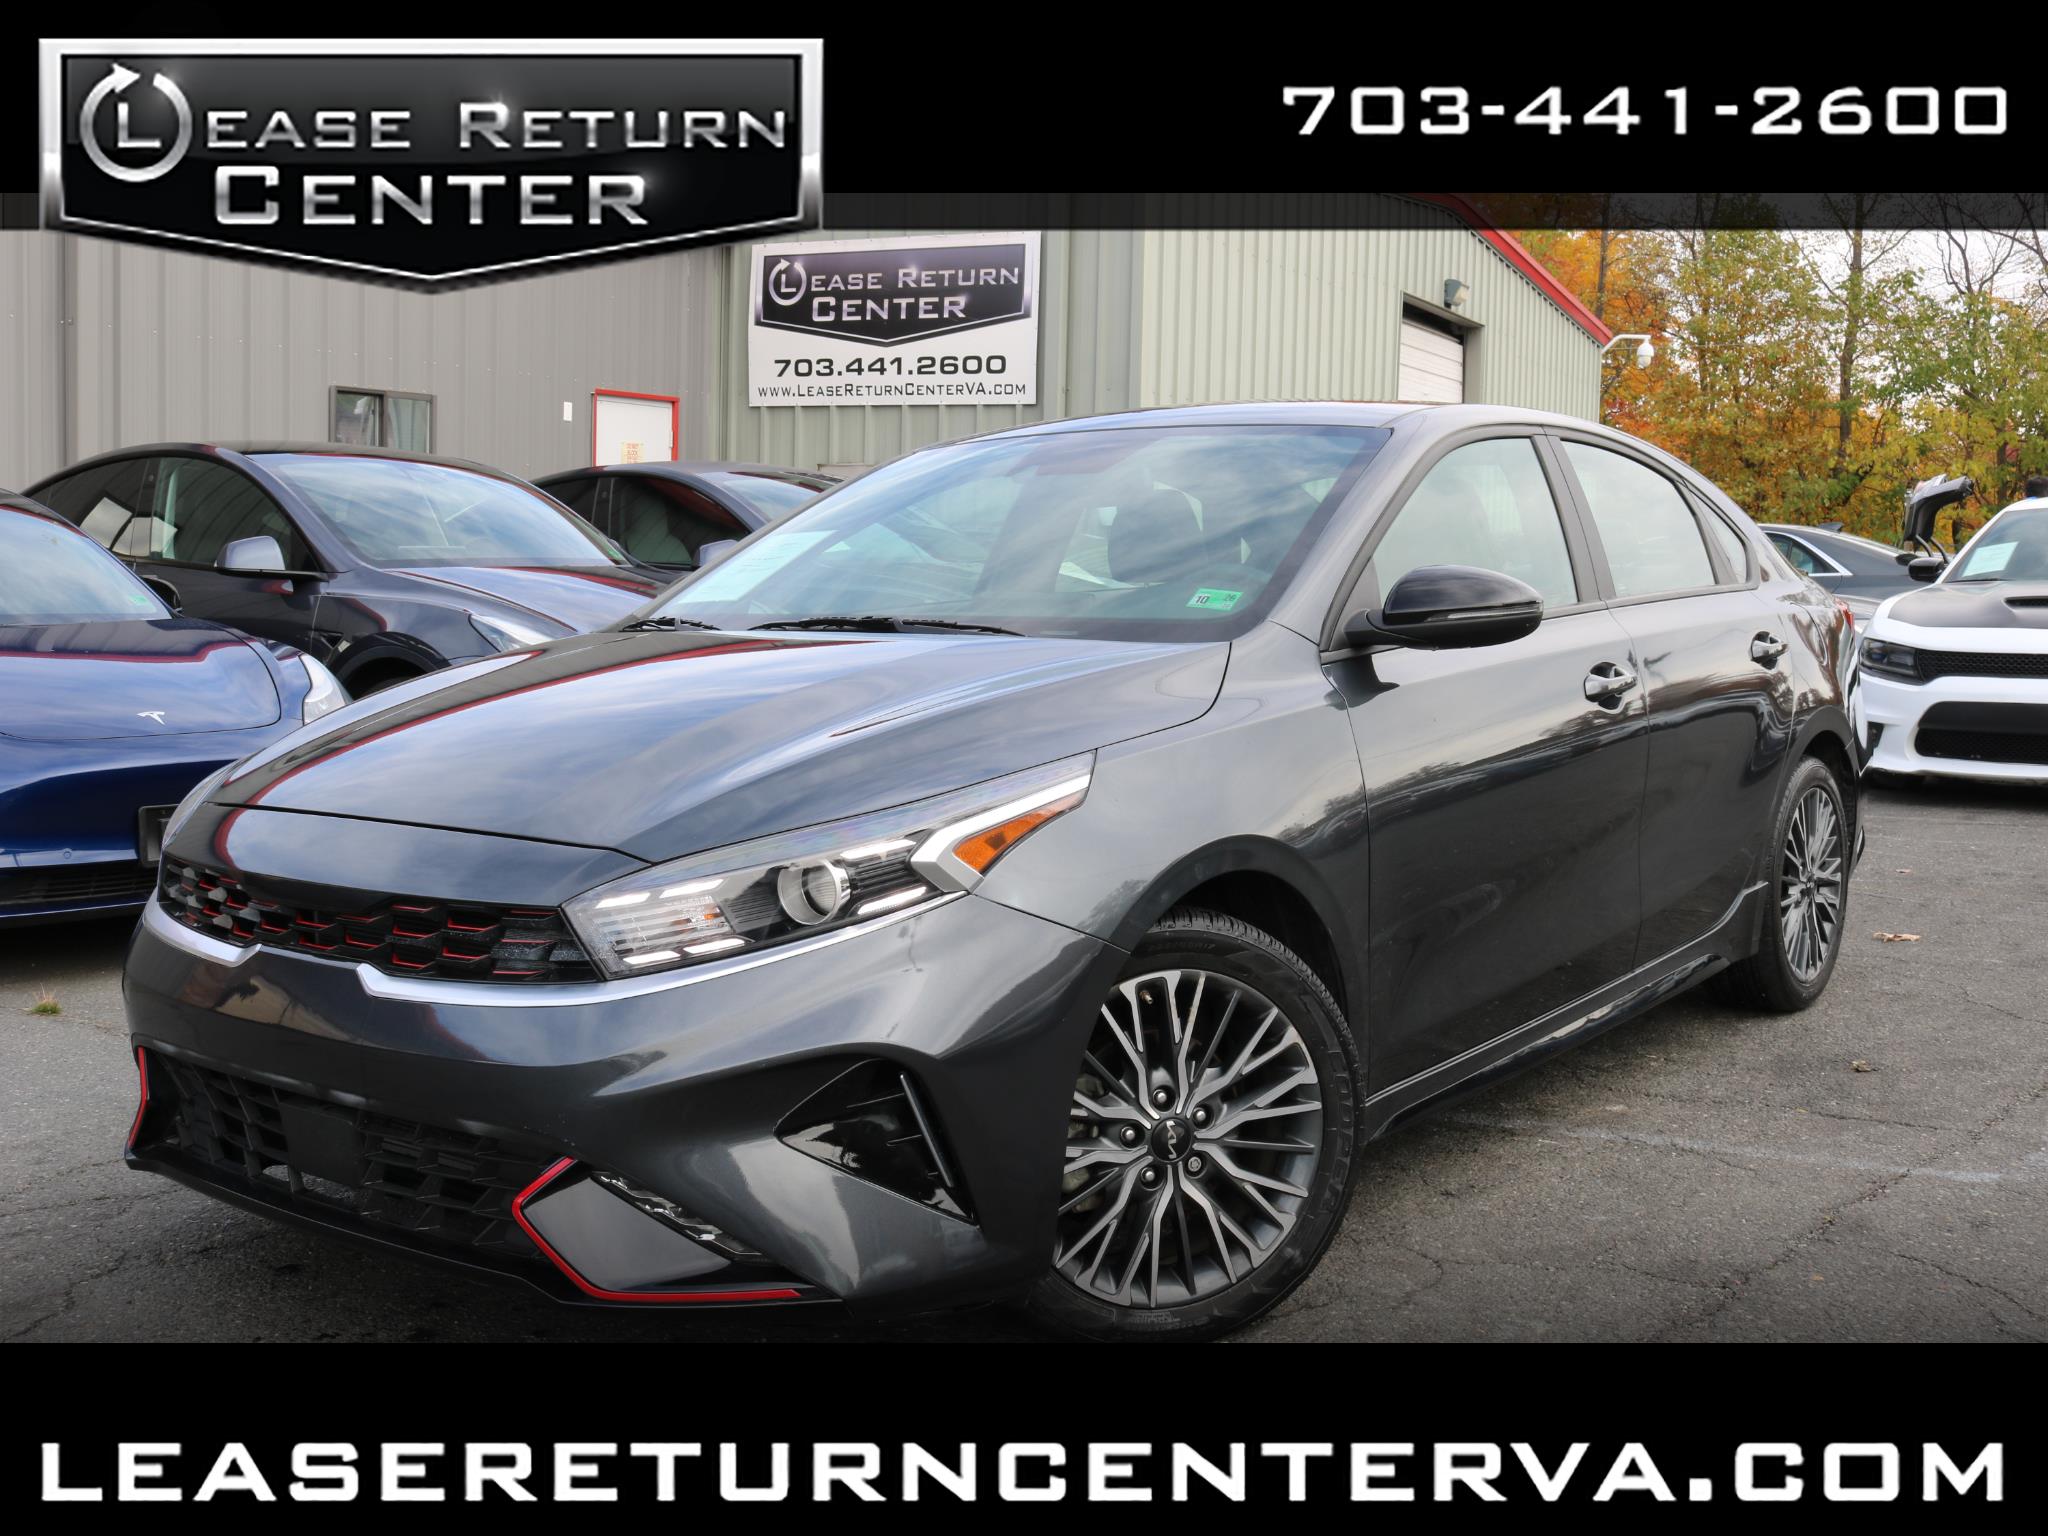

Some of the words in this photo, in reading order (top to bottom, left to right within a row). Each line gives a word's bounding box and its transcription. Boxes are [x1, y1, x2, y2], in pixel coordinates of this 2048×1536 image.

[897, 266, 1019, 289] RETURN
[812, 296, 966, 322] CENTER
[774, 355, 1007, 377] 703.441.2600
